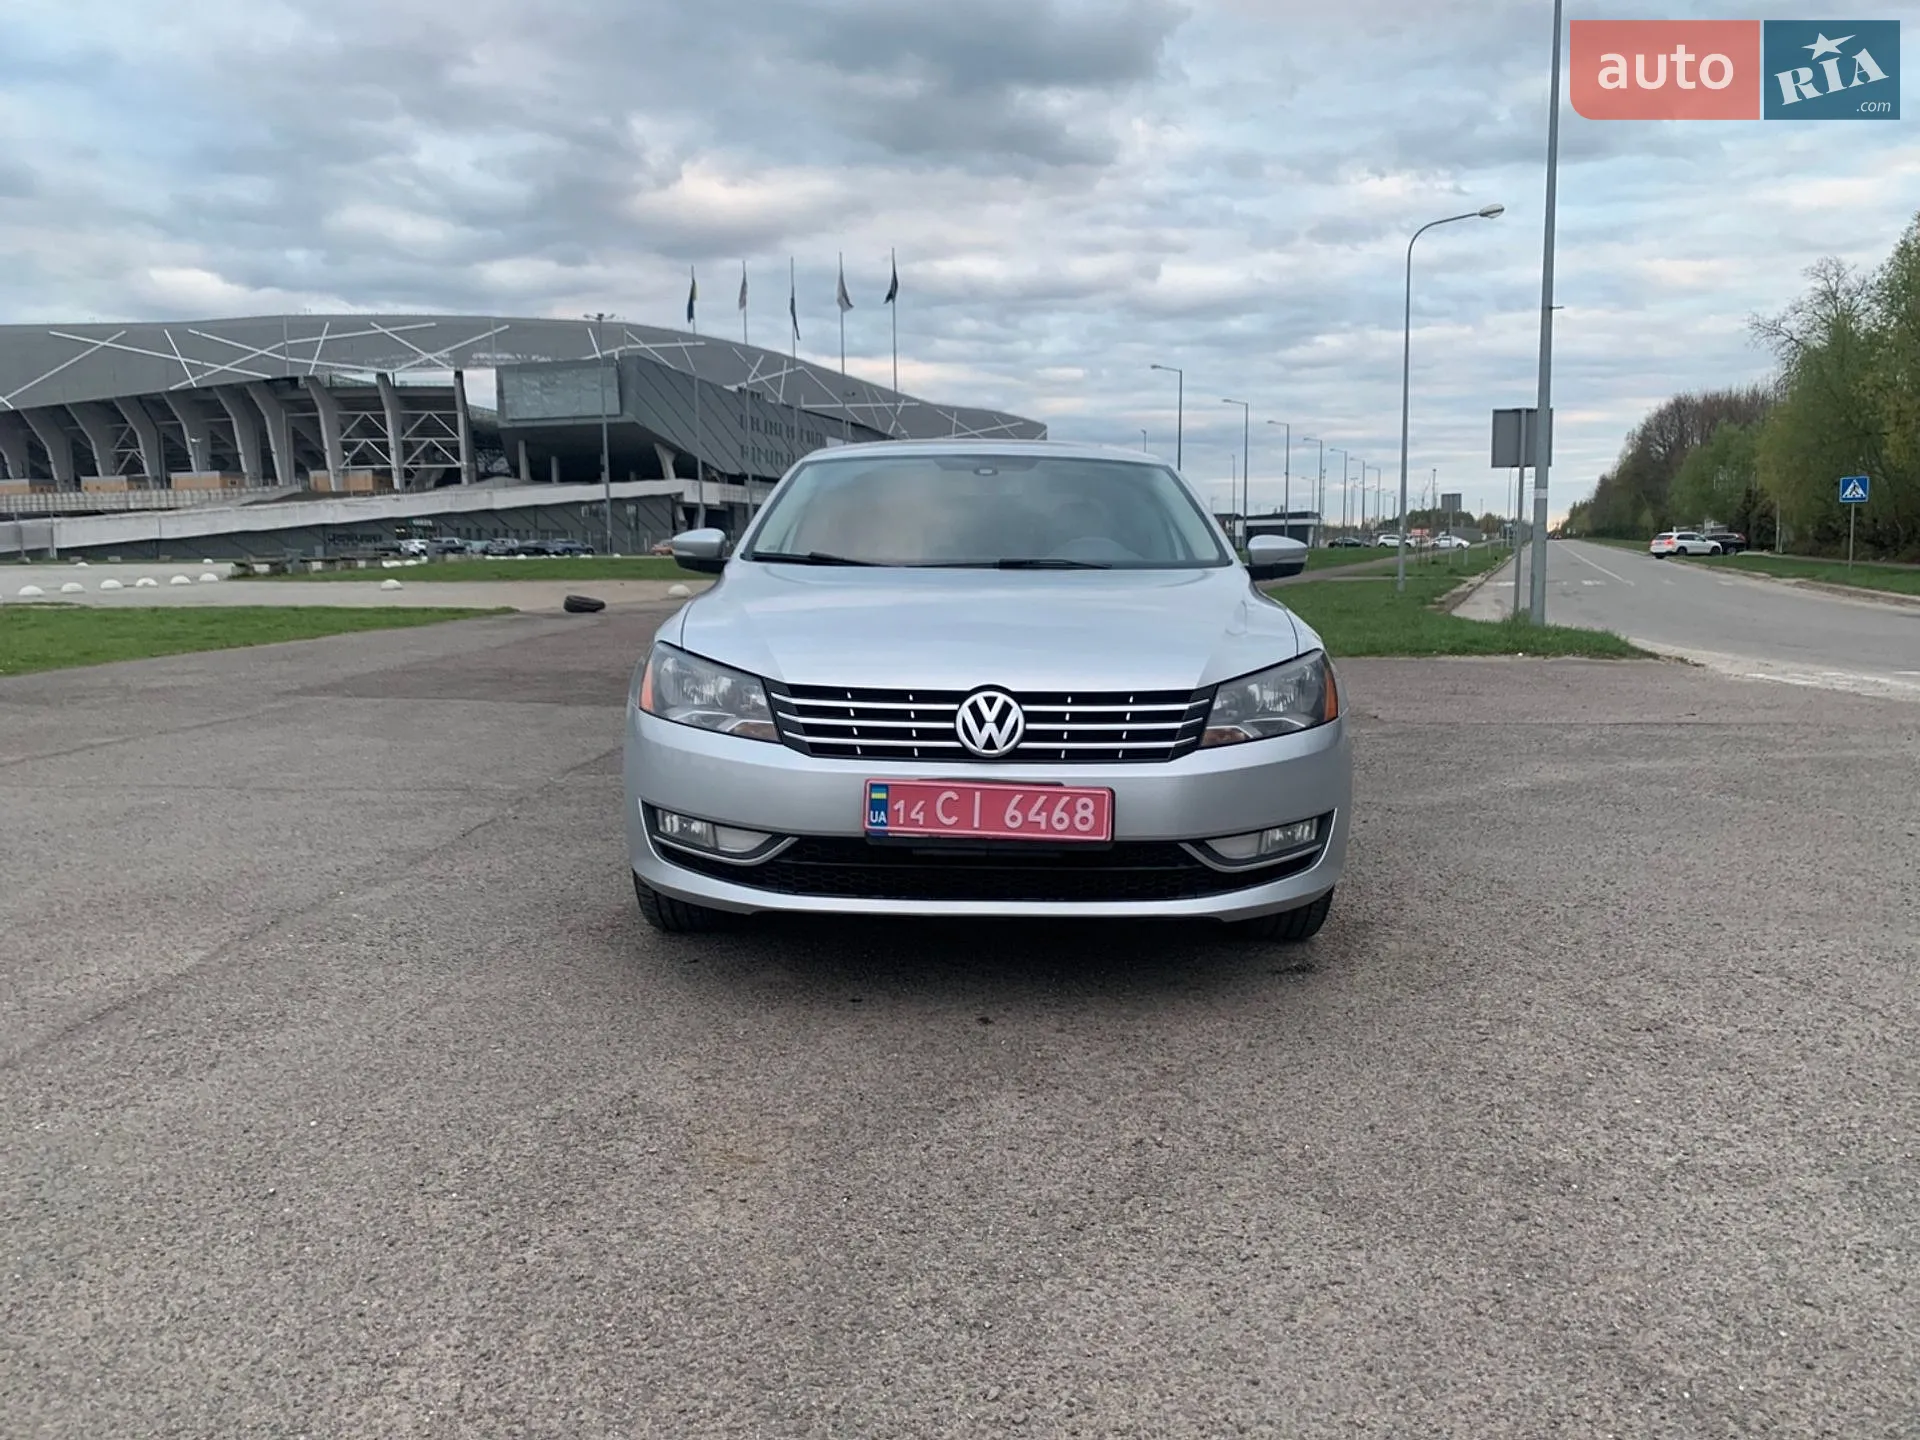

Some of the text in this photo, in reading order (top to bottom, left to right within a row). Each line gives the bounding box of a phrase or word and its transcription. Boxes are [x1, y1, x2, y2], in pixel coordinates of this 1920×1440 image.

[957, 691, 1024, 757] VW
[870, 810, 887, 824] UA
[893, 799, 926, 825] 14
[1004, 794, 1095, 832] 6468
